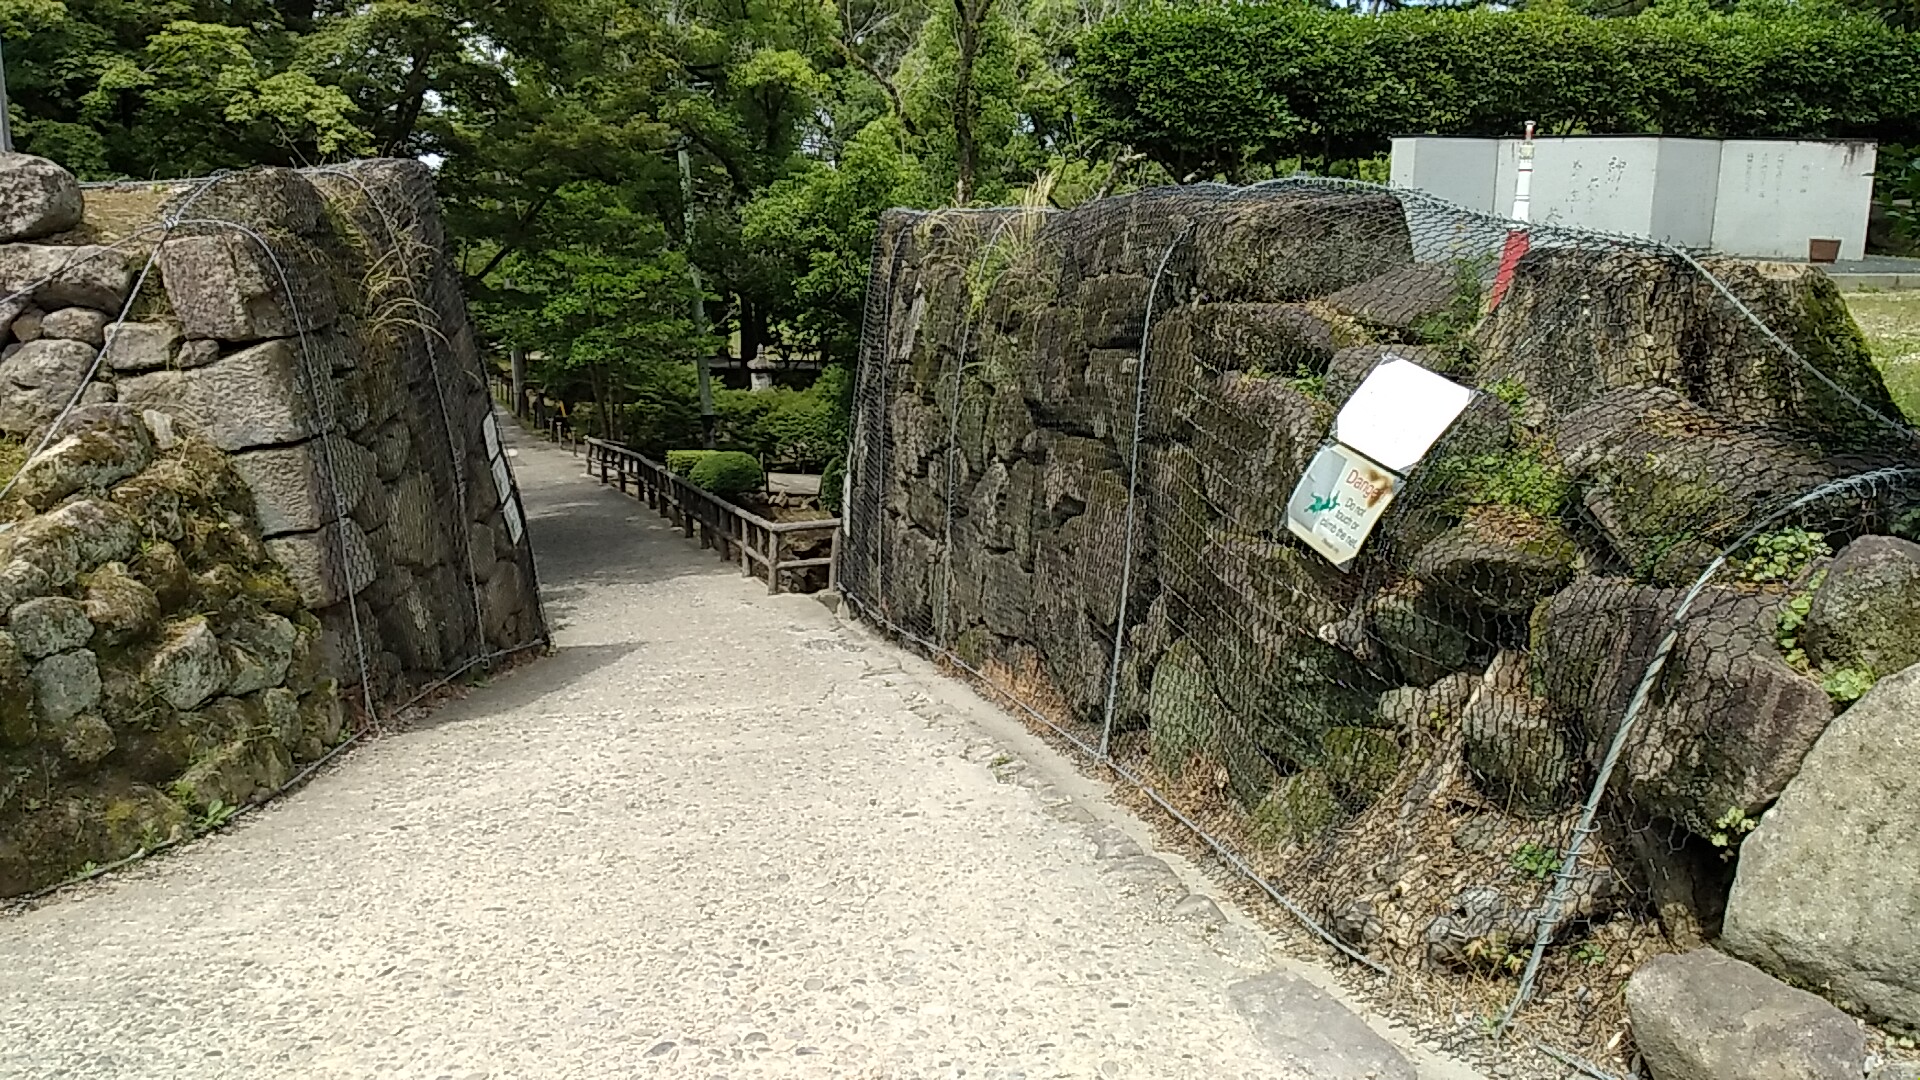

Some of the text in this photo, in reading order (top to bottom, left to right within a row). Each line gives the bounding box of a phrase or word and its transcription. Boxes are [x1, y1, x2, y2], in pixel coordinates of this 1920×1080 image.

[1345, 497, 1367, 517] Do not
[1320, 518, 1337, 533] climb
[1336, 528, 1347, 540] the
[1335, 510, 1360, 530] touch or
